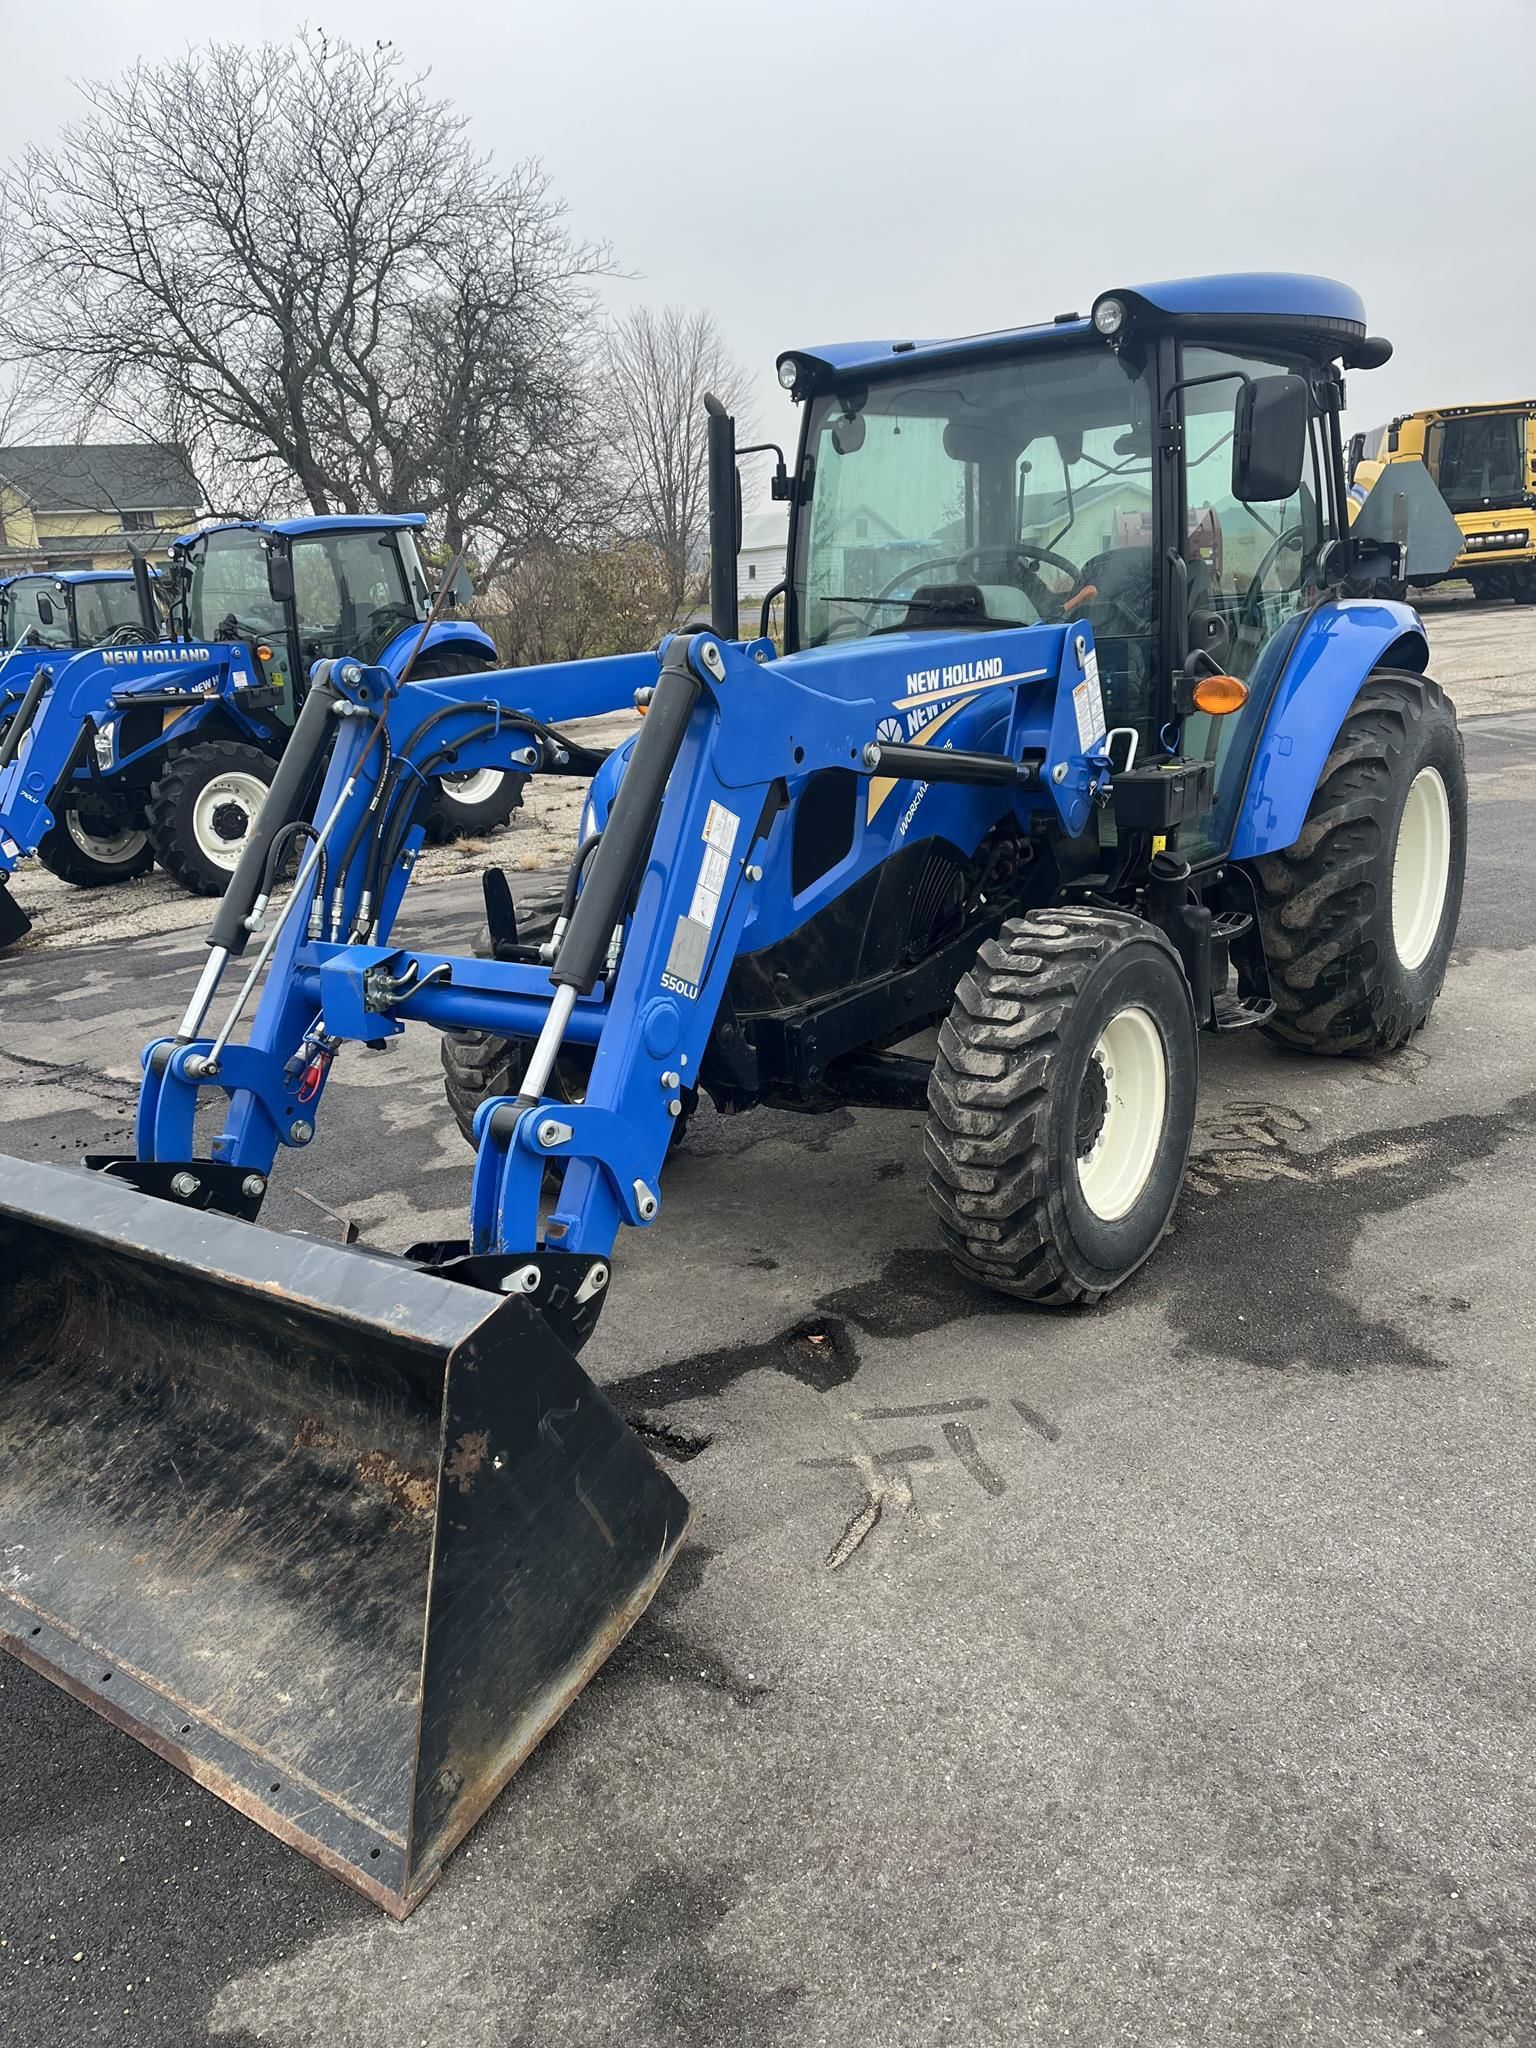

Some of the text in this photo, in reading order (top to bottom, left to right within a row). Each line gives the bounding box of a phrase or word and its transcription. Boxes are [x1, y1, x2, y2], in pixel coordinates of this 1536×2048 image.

[102, 649, 210, 664] NEW HOLLAND
[191, 678, 212, 693] NEW
[907, 657, 1003, 695] NEW HOLLAND
[660, 973, 698, 999] 550LU
